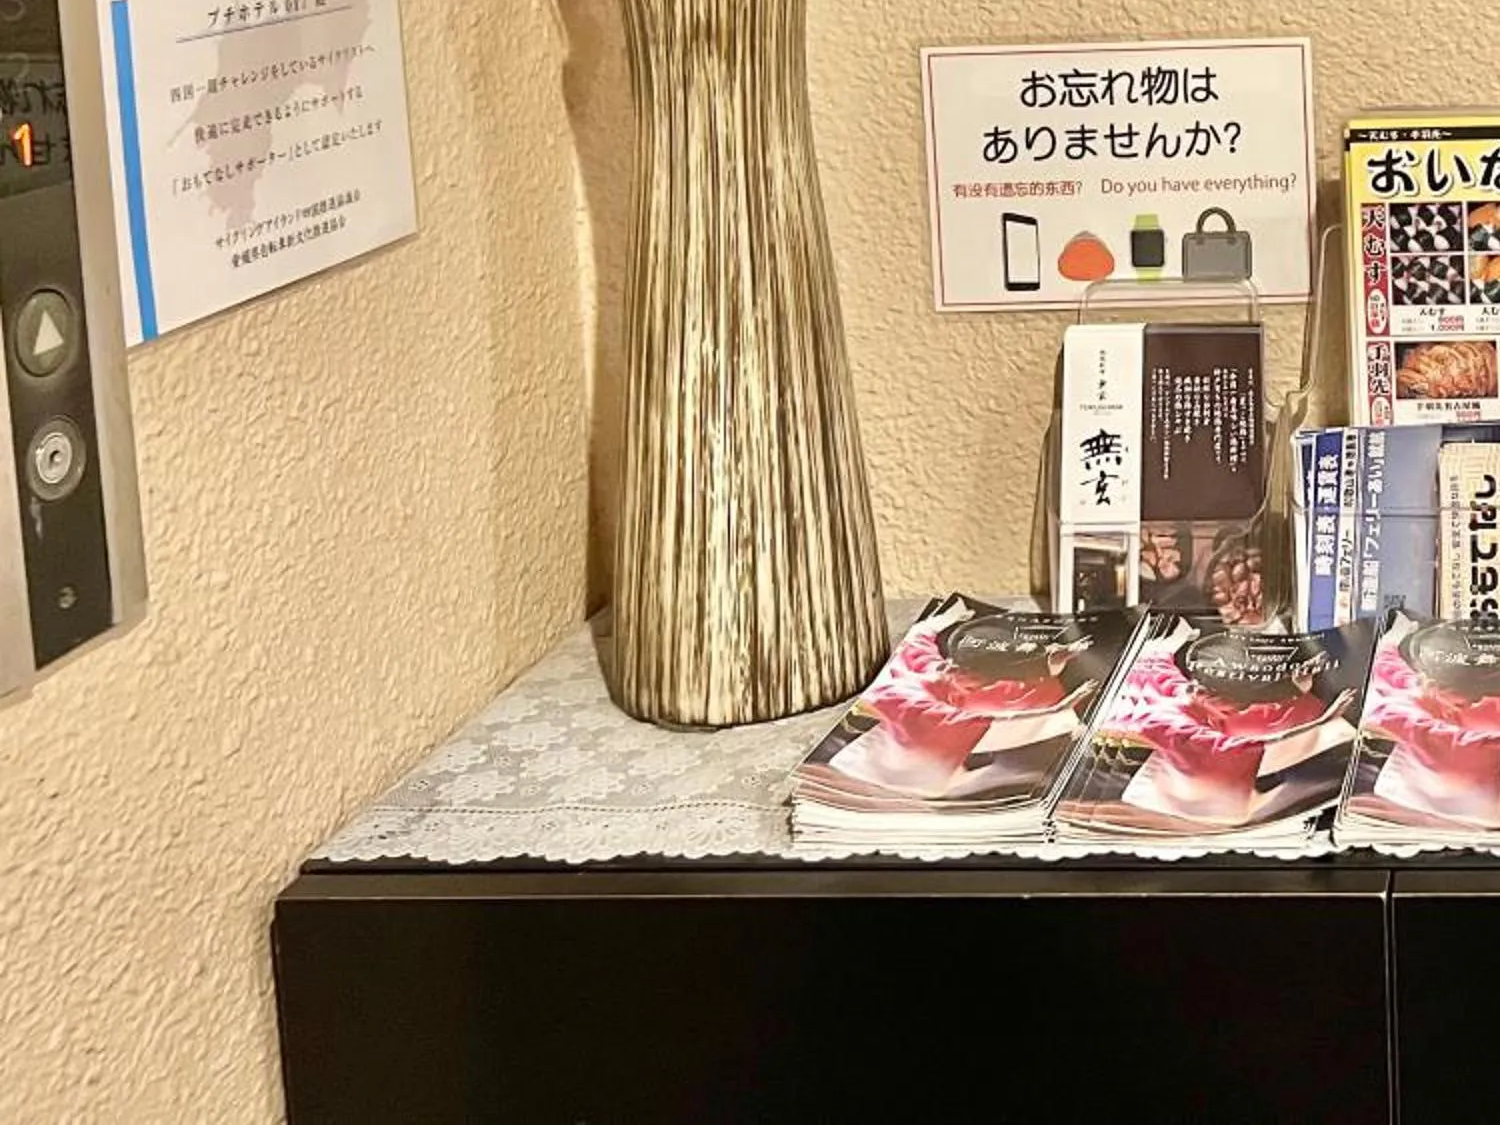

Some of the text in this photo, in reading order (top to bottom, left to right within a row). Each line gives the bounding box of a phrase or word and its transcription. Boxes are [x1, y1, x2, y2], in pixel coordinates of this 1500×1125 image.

[1020, 66, 1219, 108] お忘れ物は
[12, 122, 33, 166] 1
[983, 120, 1242, 164] ありませんか?
[1101, 172, 1297, 198] Do you have everything?
